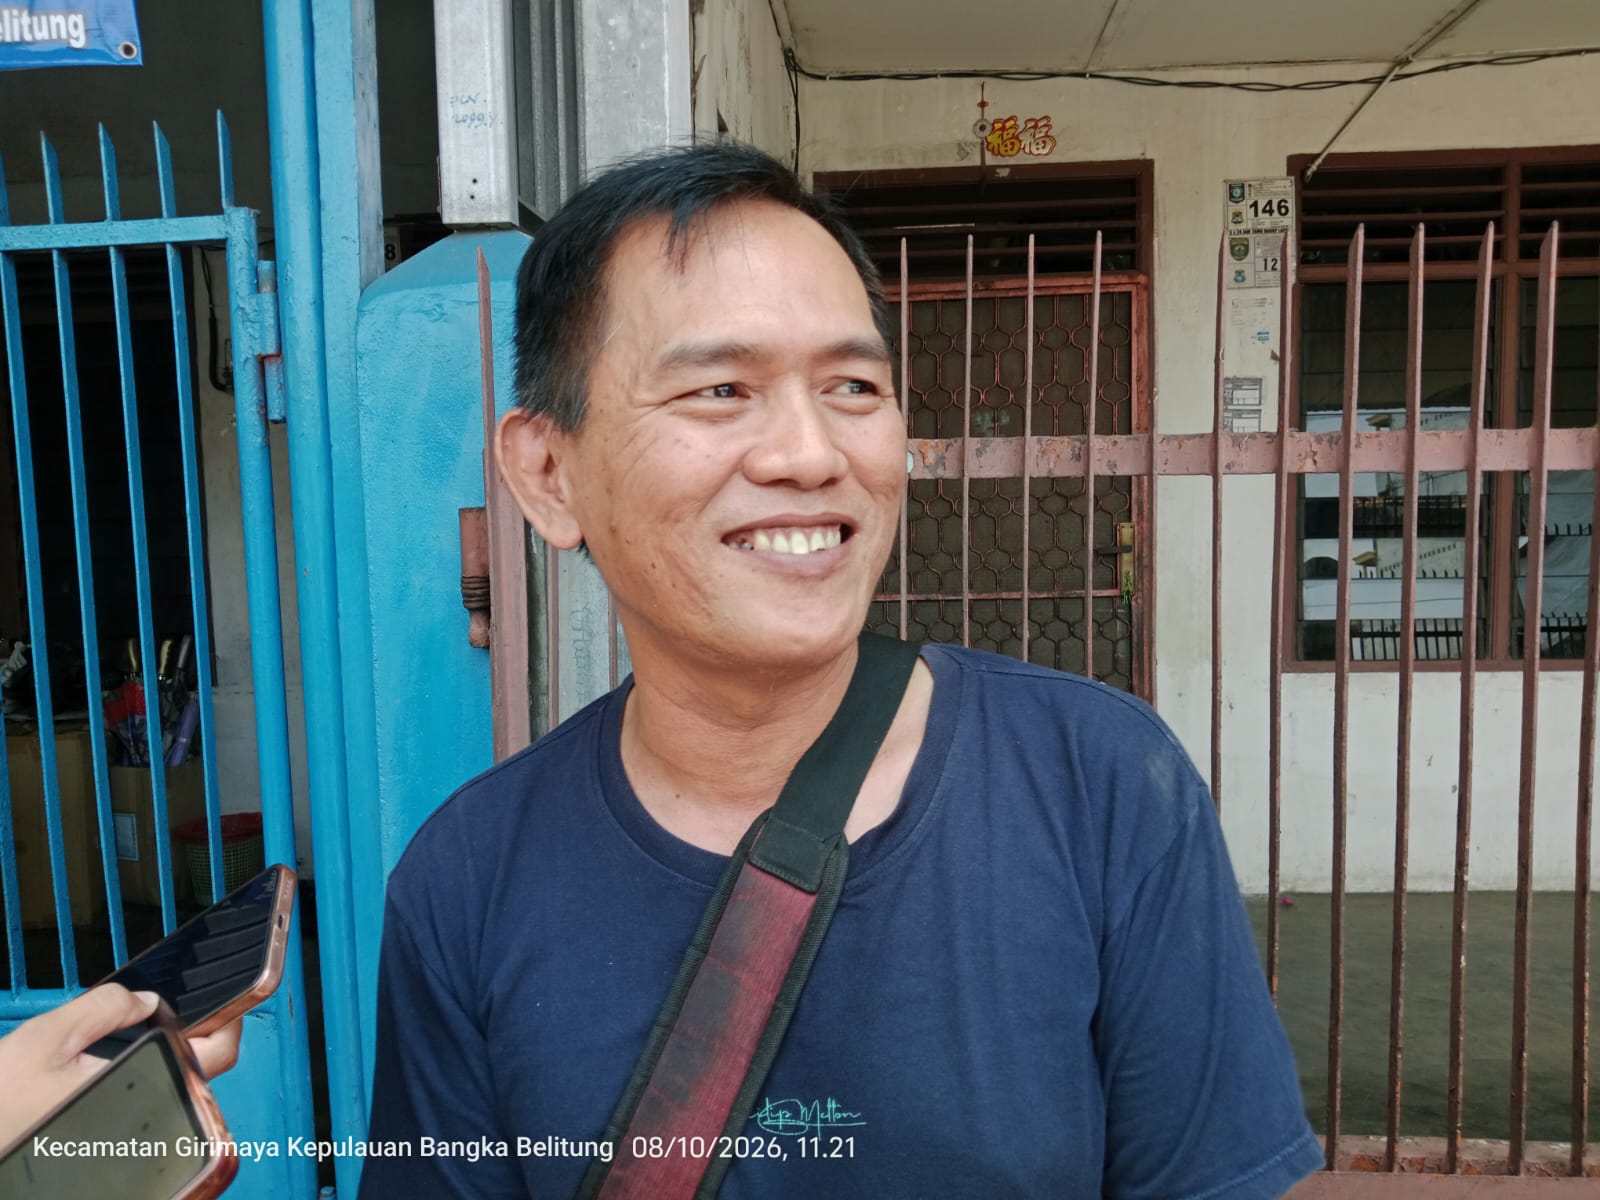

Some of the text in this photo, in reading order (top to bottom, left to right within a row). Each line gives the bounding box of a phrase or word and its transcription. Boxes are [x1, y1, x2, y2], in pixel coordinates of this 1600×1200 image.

[0, 8, 86, 48] litung
[1249, 198, 1290, 218] 146
[1263, 257, 1278, 272] 12
